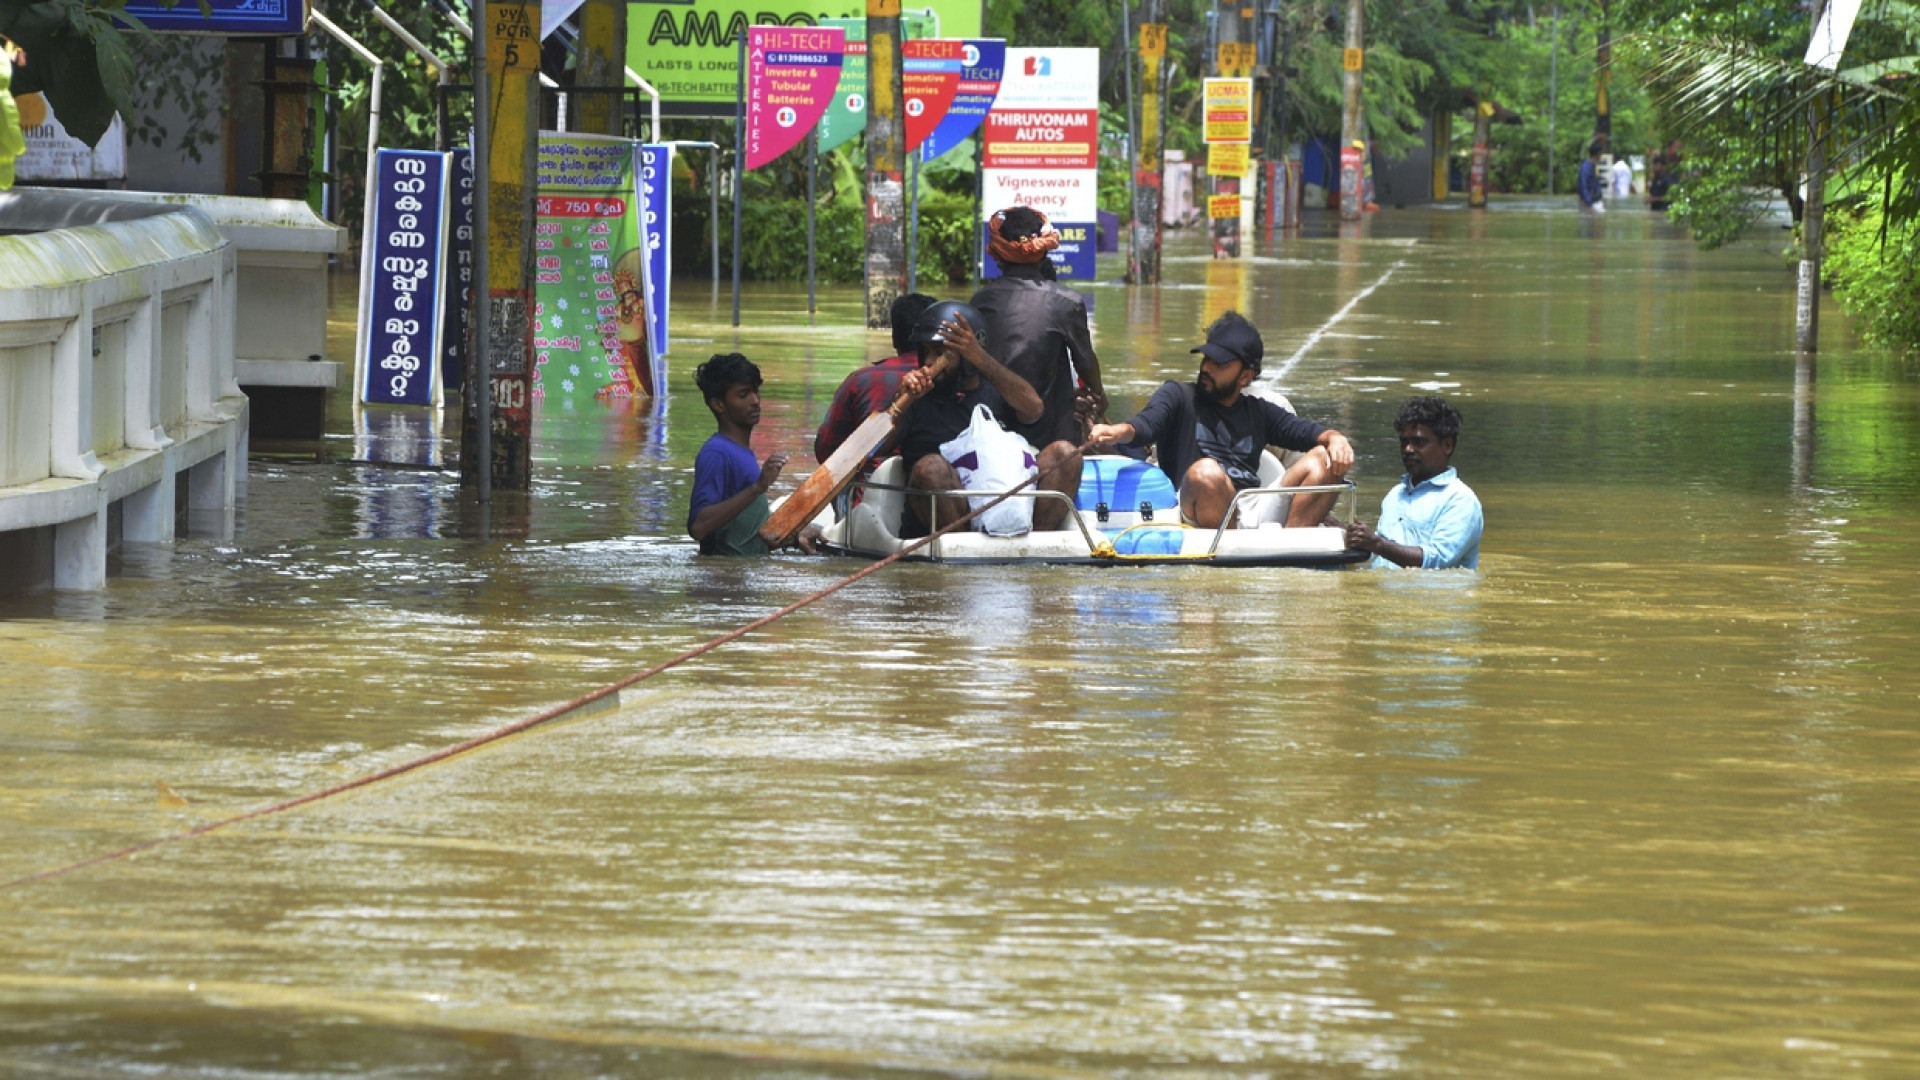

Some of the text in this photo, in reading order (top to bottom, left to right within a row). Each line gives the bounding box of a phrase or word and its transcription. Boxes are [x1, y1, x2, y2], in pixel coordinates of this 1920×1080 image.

[764, 32, 831, 50] HI-TECH
[506, 44, 519, 66] 5
[647, 60, 693, 70] LASTS
[765, 67, 818, 78] Inverter &
[658, 82, 737, 93] HI-TECH BATTER
[771, 80, 811, 91] Tubular
[1208, 84, 1247, 97] UCMAS
[767, 94, 814, 105] Batteries
[988, 112, 1088, 127] THIRUVONAM
[1015, 127, 1065, 141] AUTOS
[996, 175, 1080, 190] Vigneswara
[1014, 193, 1067, 207] Agency
[565, 202, 591, 213] 750
